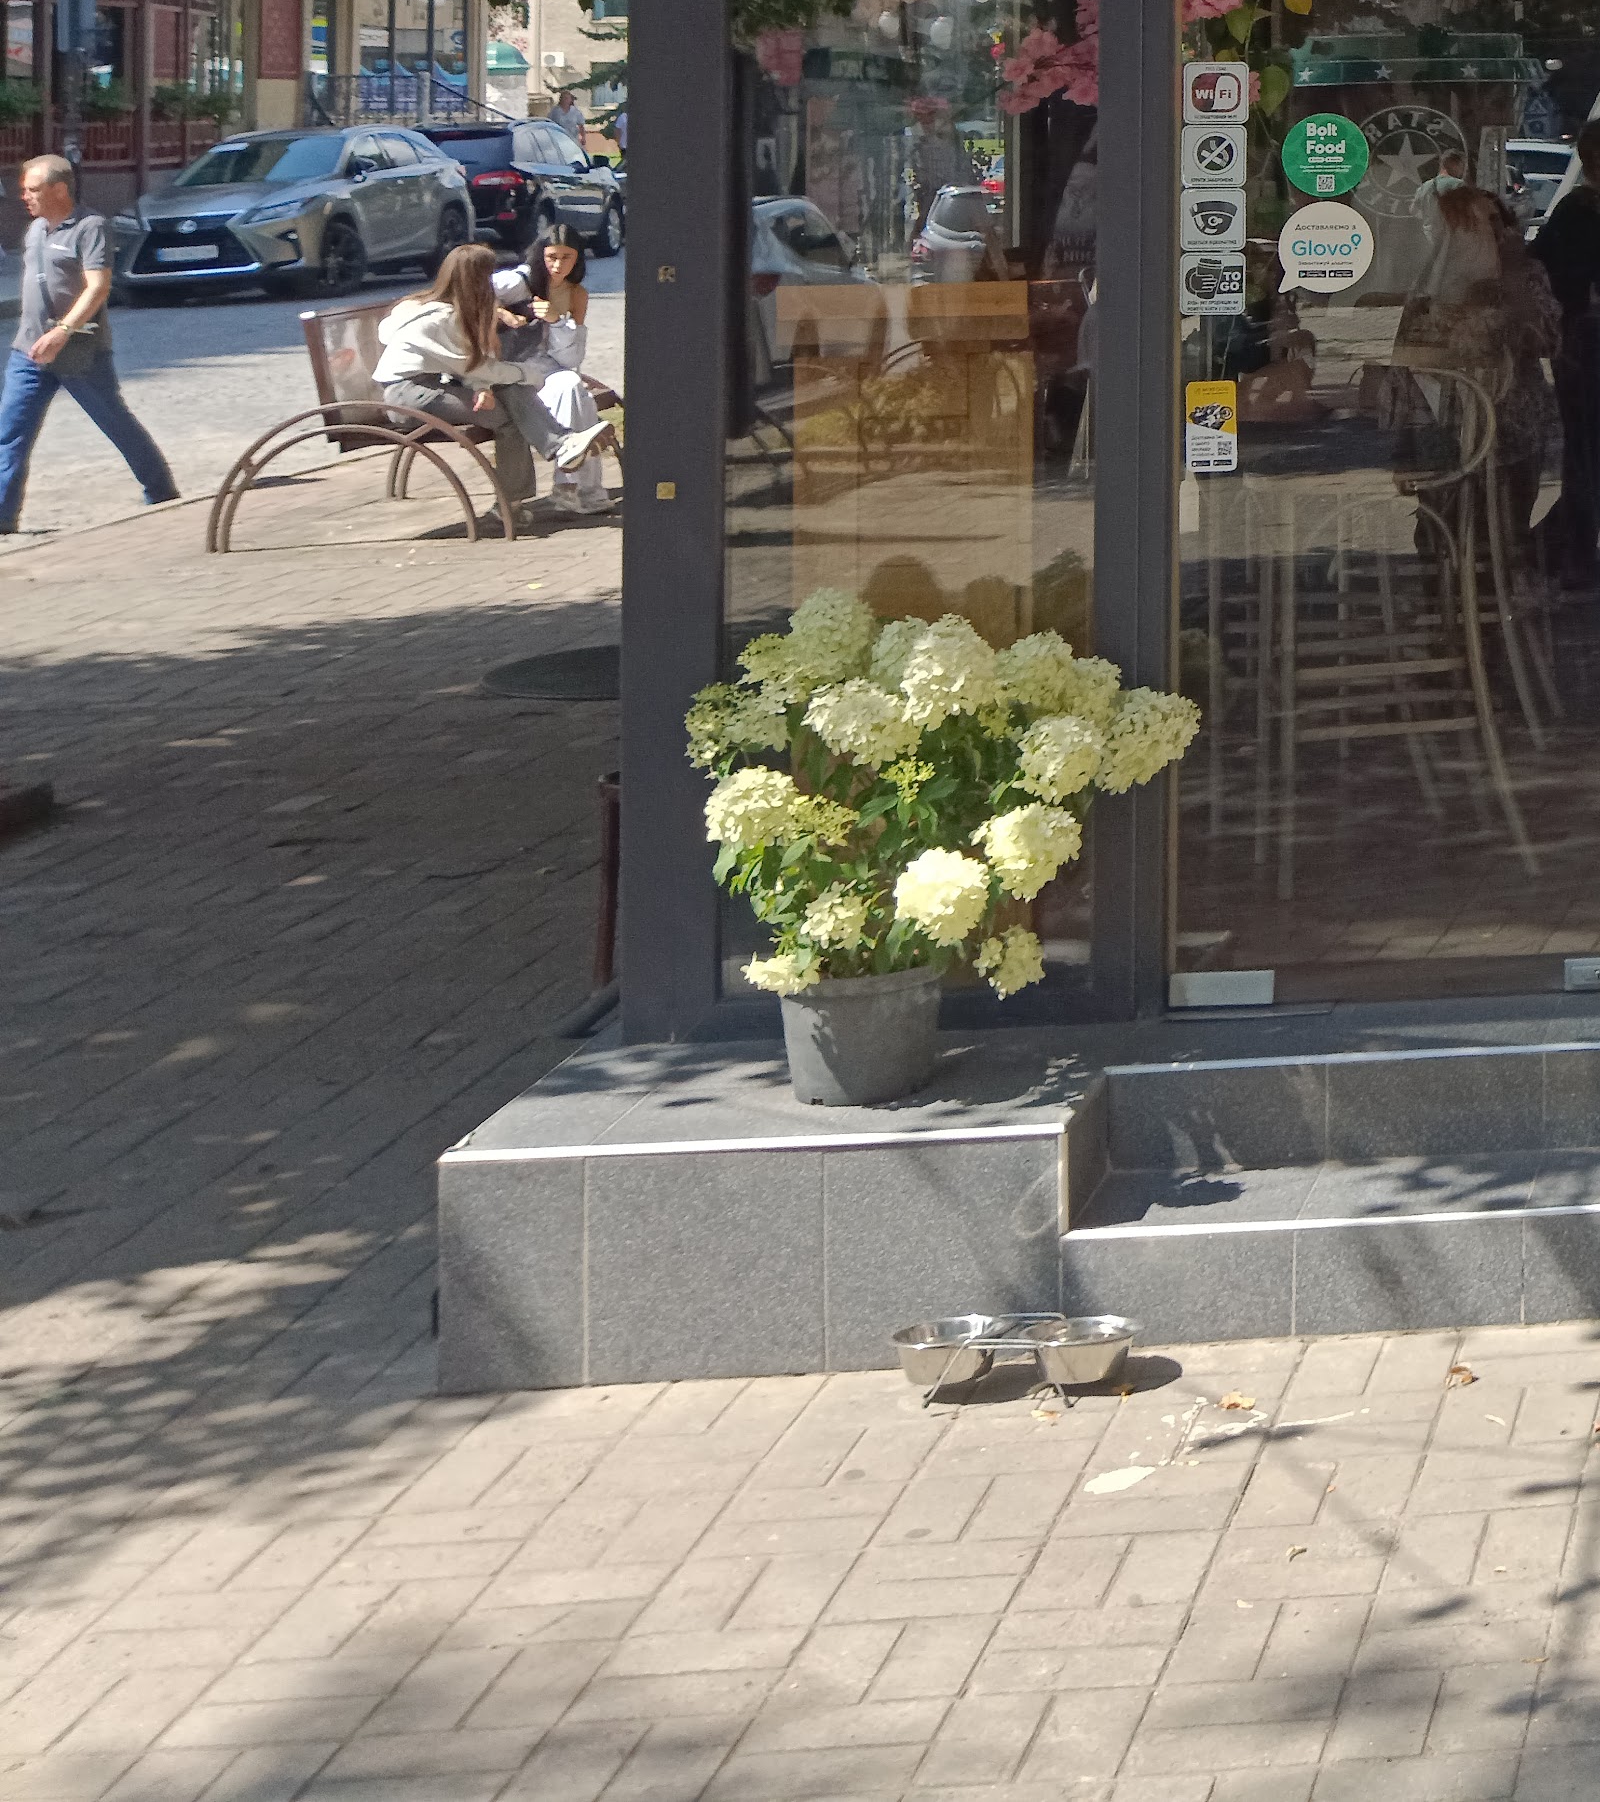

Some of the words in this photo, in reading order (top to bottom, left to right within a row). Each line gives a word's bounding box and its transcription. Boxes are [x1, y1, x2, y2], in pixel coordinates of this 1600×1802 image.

[1306, 122, 1338, 137] Bolt
[1306, 139, 1346, 154] Food
[1291, 239, 1353, 256] Glovo
[1223, 271, 1242, 281] TO
[1219, 281, 1241, 292] GO
